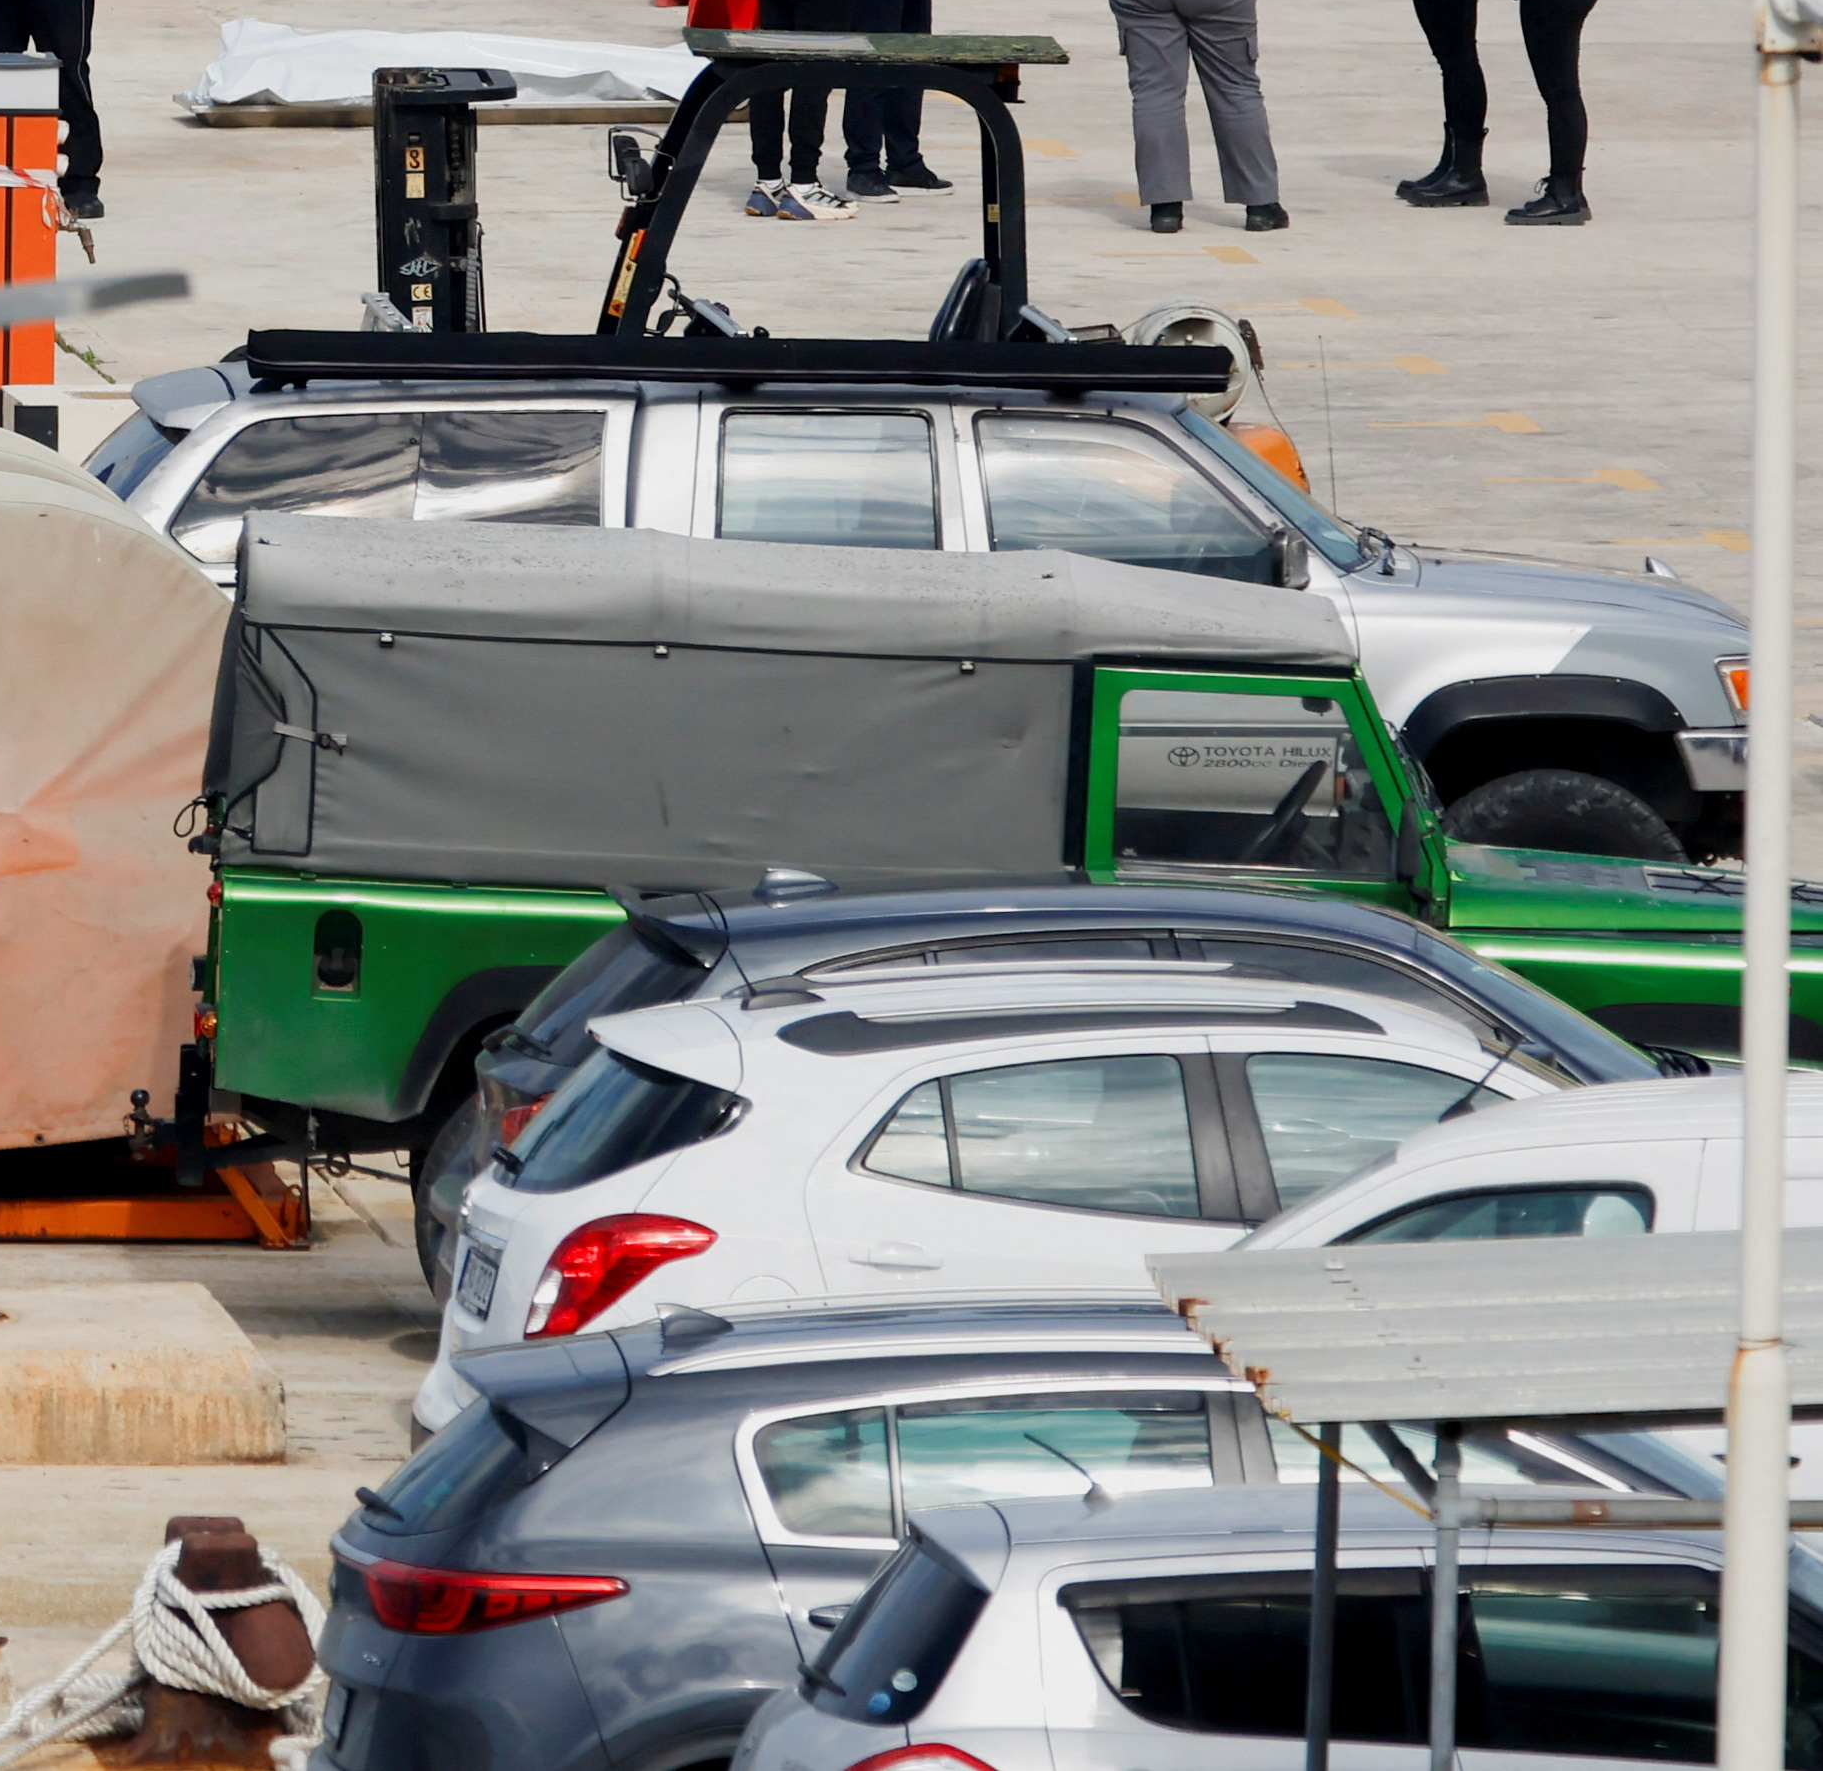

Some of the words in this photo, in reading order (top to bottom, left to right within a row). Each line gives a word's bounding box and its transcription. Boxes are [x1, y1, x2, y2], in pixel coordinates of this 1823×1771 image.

[414, 286, 431, 299] CE
[1203, 746, 1275, 757] TOYOTA
[1283, 747, 1331, 757] HILUX
[1204, 759, 1272, 768] 2800cc
